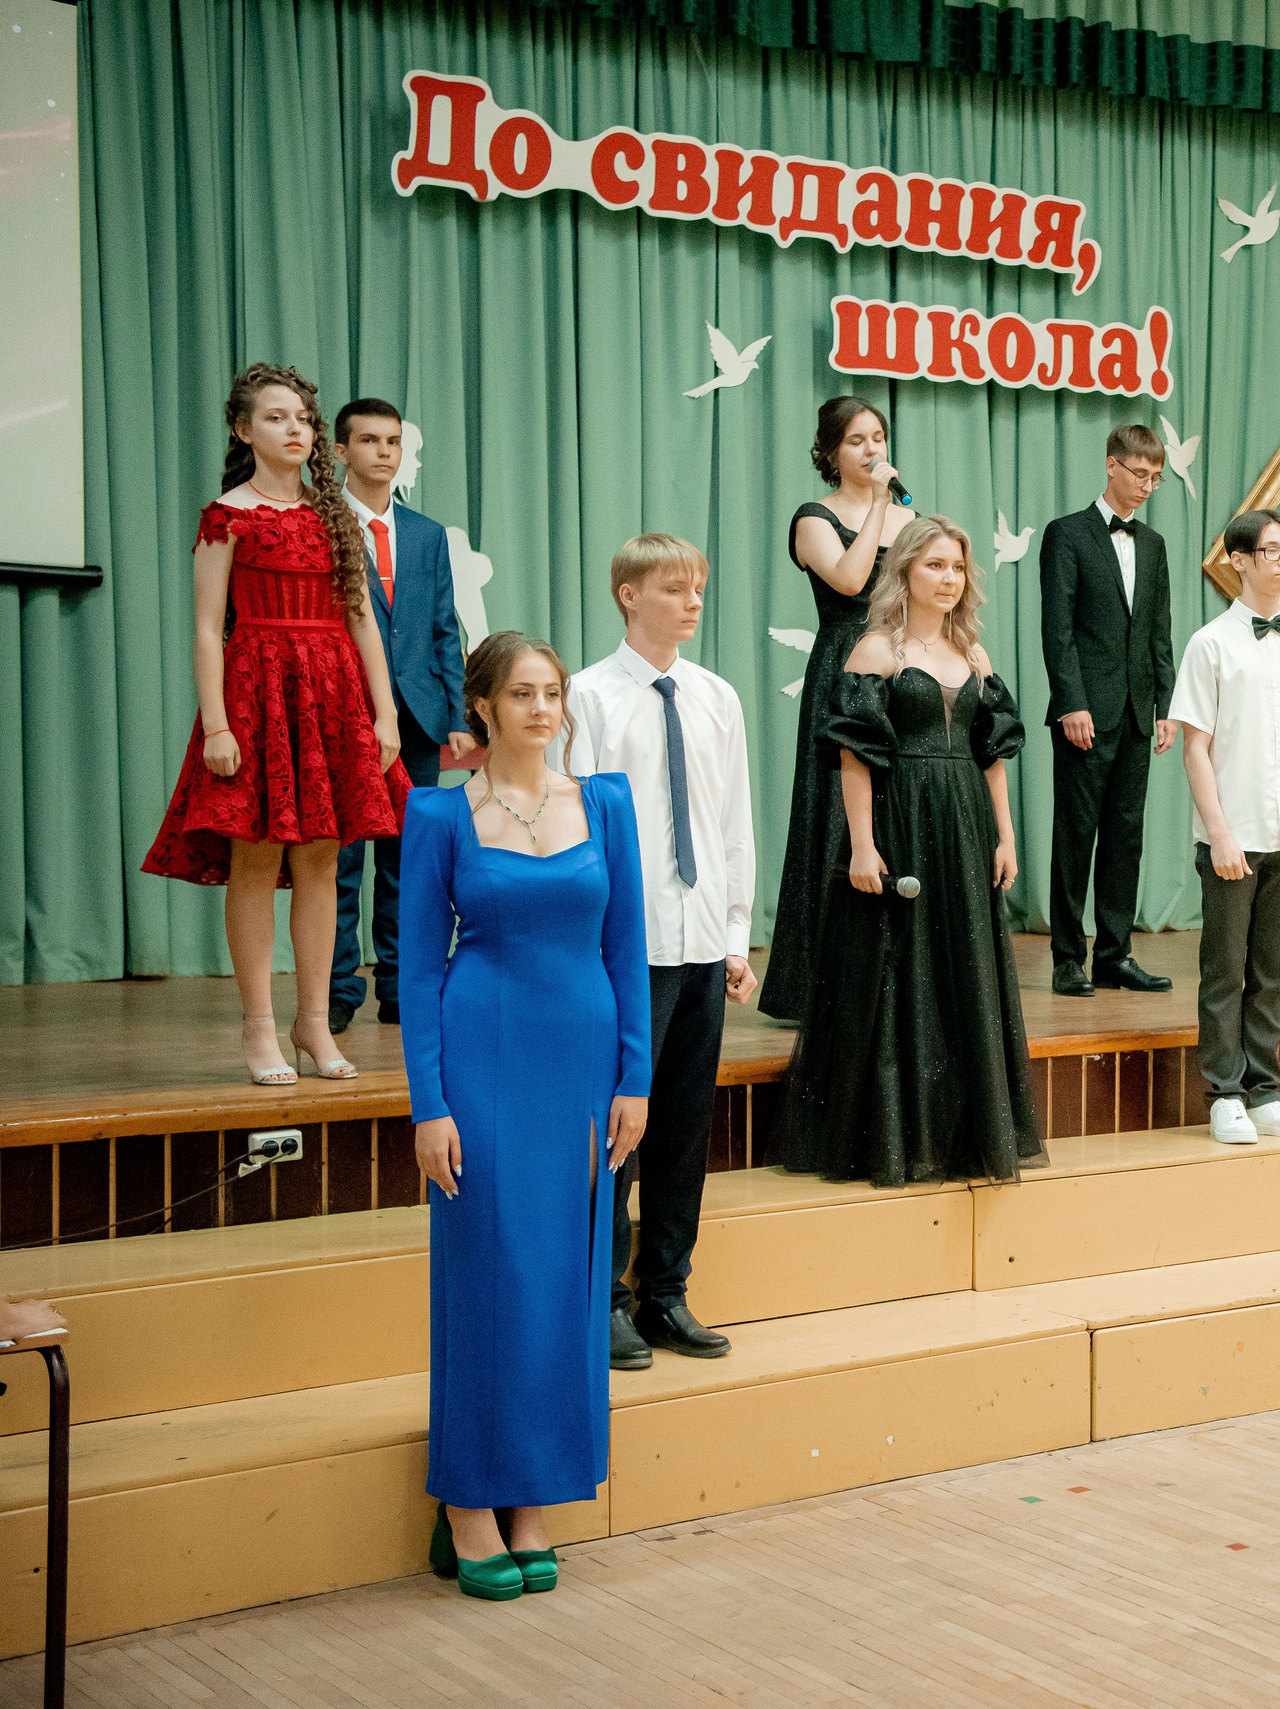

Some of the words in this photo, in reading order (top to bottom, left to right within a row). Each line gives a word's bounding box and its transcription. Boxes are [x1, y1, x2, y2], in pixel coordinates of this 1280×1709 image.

[396, 75, 553, 201] До
[590, 131, 1097, 293] свидания,
[833, 300, 1170, 397] школа!
